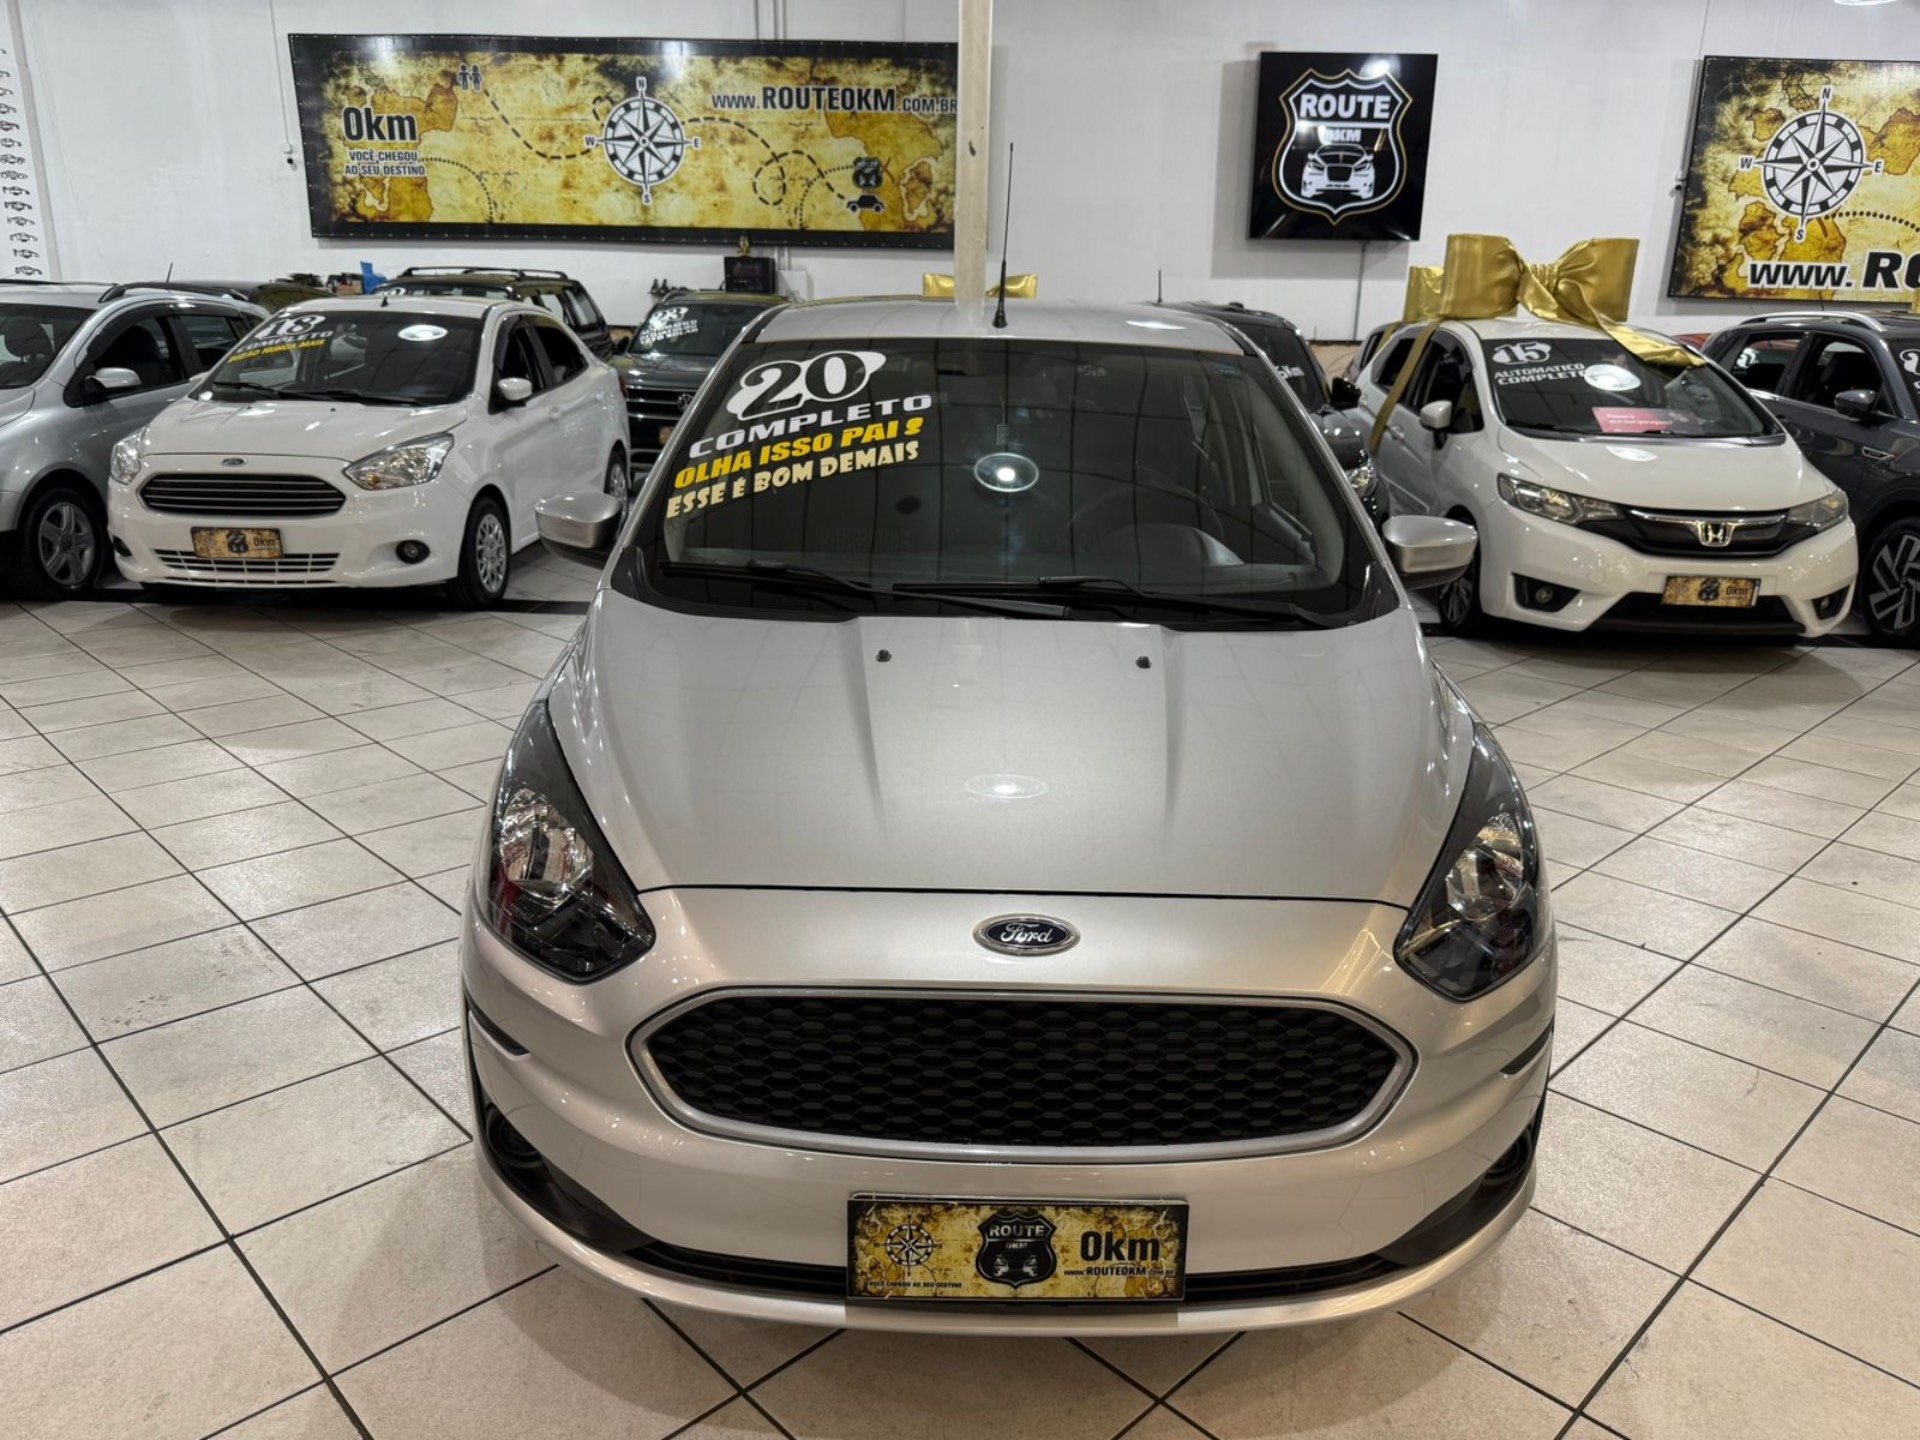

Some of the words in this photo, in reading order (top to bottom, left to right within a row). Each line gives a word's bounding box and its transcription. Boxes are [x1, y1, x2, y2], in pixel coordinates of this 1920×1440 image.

[1823, 88, 1831, 99] N
[1300, 94, 1391, 119] ROUTE
[343, 107, 417, 140] 0km
[378, 151, 418, 162] CHEGOU
[1740, 158, 1752, 169] W
[1874, 162, 1882, 173] E
[345, 165, 358, 175] AO
[361, 165, 380, 175] SEU
[383, 165, 425, 175] DESTINO
[1796, 229, 1804, 241] S
[254, 314, 326, 340] 18
[1492, 341, 1552, 365] 15
[727, 350, 887, 421] 20
[689, 394, 933, 459] COMPLETO
[674, 450, 752, 489] OLHA
[759, 433, 834, 466] ISSO
[666, 479, 726, 519] ESSE
[732, 476, 747, 500] É
[753, 459, 813, 493] BOM
[820, 440, 919, 478] DEMAIS
[1001, 922, 1053, 943] Ford
[989, 1224, 1046, 1237] ROUTE
[1081, 1231, 1159, 1261] 0km
